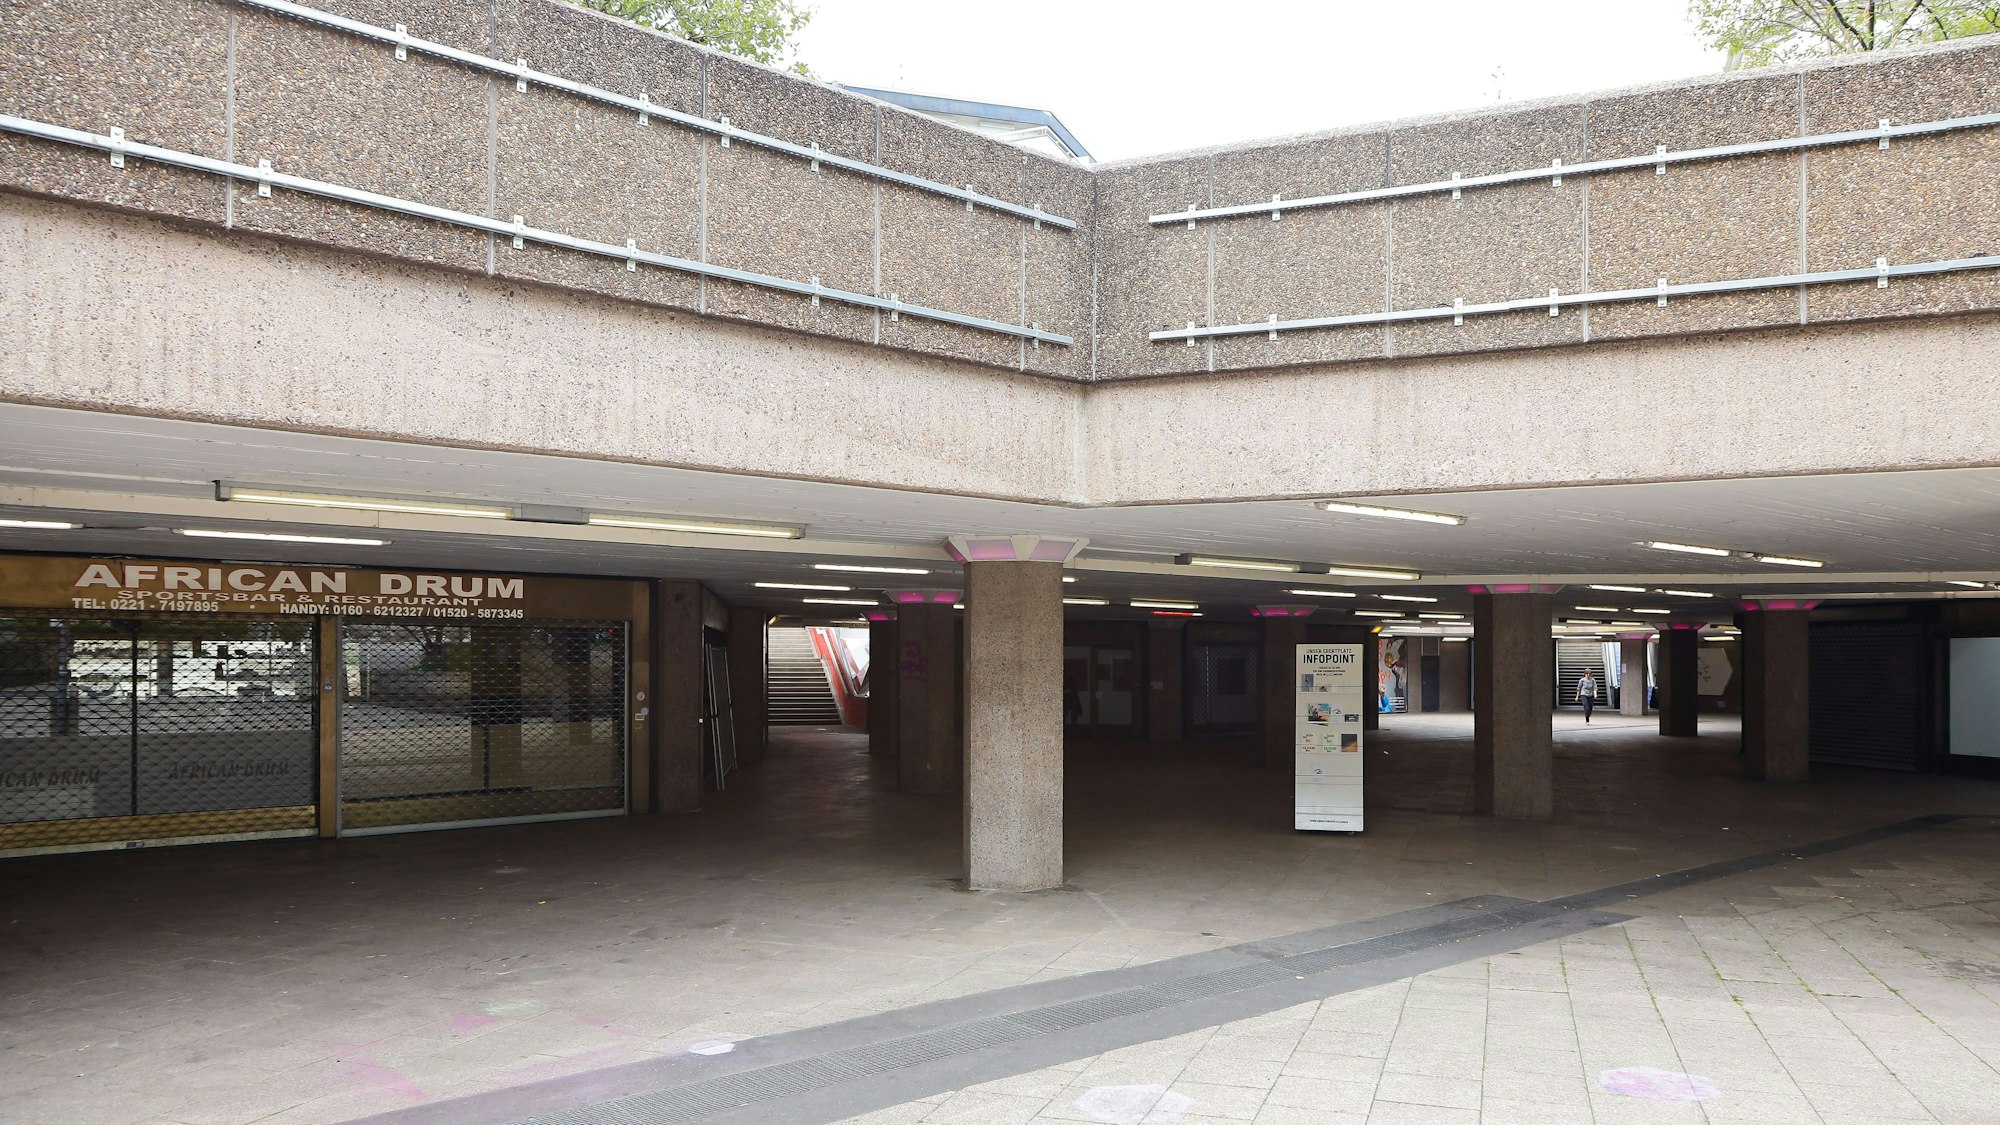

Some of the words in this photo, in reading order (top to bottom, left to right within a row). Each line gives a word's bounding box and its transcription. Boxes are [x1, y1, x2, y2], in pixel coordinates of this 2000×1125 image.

[74, 564, 347, 594] AFRICAN
[379, 573, 524, 599] DRUM
[117, 590, 286, 602] SPORTSBAR
[296, 594, 314, 603] &
[324, 595, 483, 606] RESTAURANT
[71, 598, 106, 610] TEL:
[110, 600, 145, 611] 0221
[159, 601, 219, 612] 7197895
[280, 603, 329, 615] HANDY:
[333, 605, 363, 616] 0160
[373, 606, 424, 617] 6212327
[426, 607, 431, 617] /
[433, 607, 468, 618] 01520
[477, 608, 524, 619] 5873345
[1303, 654, 1355, 663] INFOPOINT
